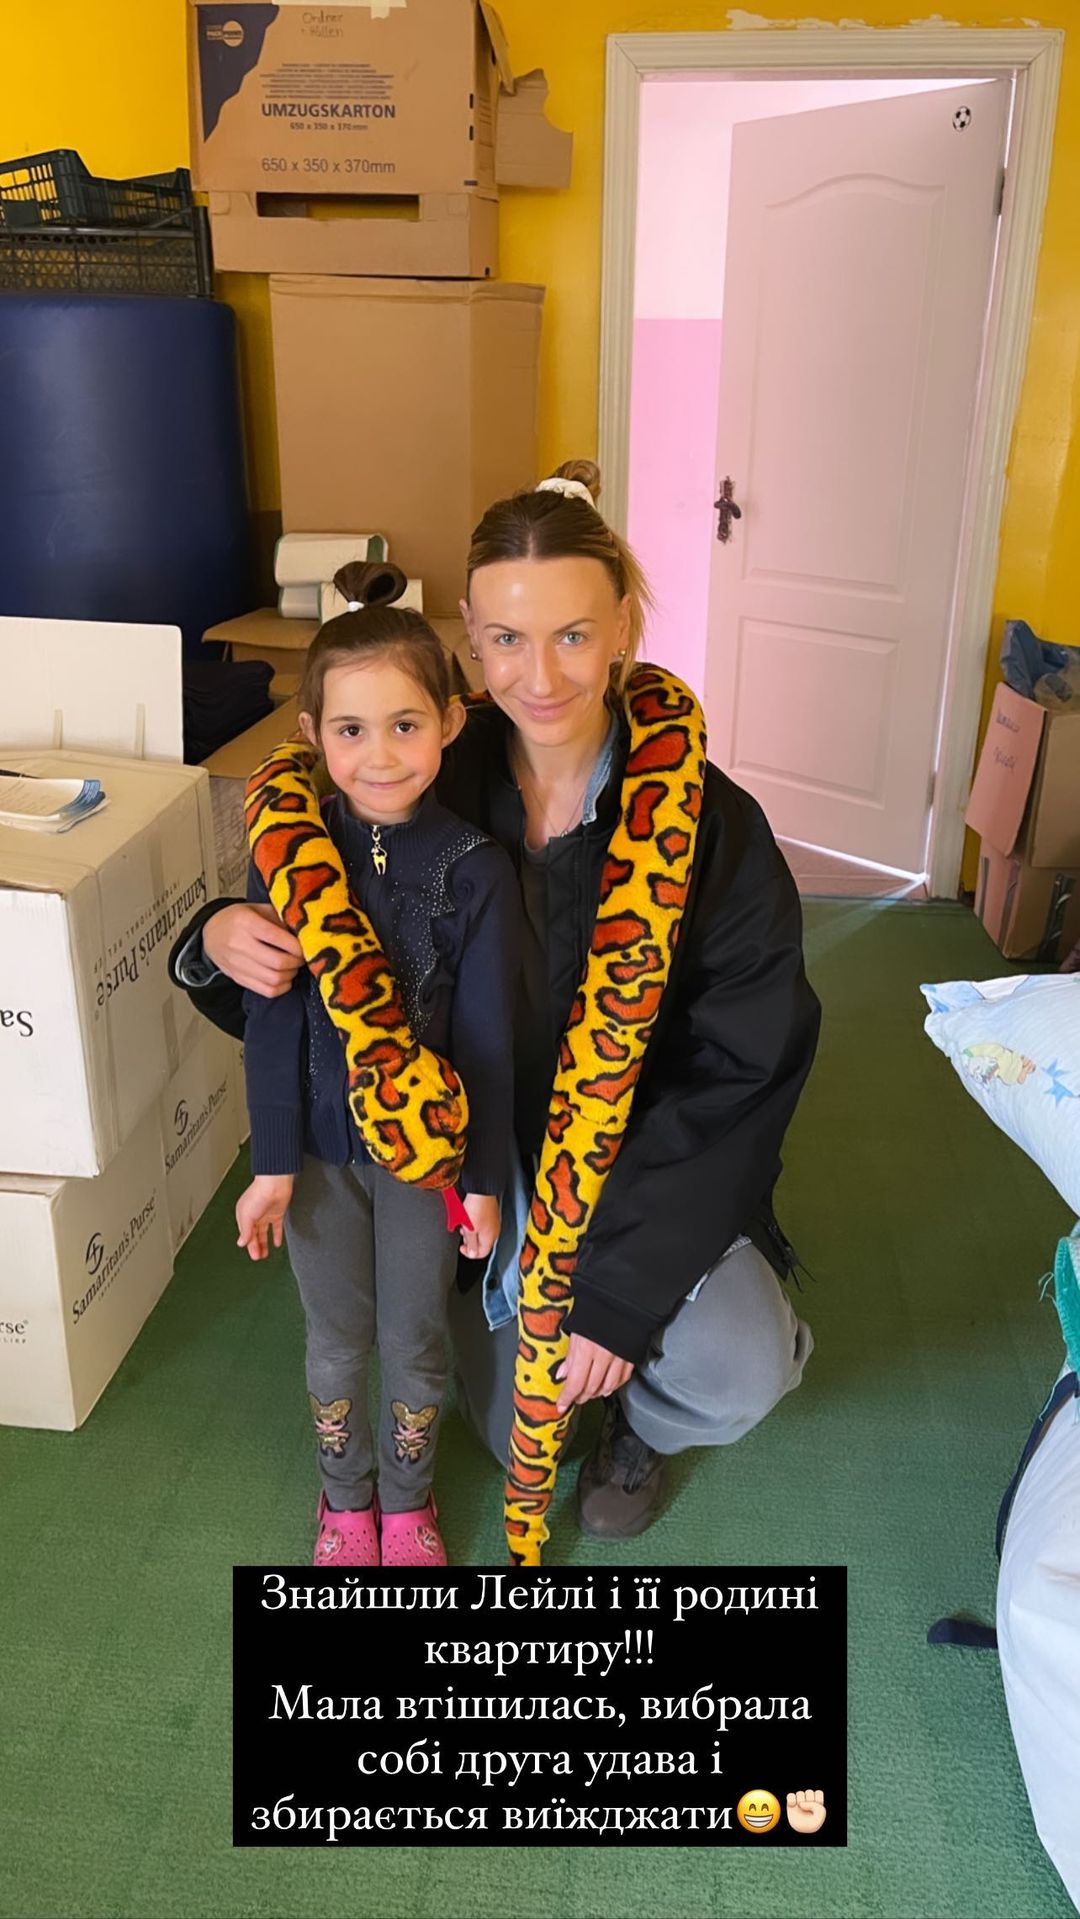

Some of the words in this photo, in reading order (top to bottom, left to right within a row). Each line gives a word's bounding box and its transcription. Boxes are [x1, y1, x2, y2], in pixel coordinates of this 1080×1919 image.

[262, 103, 396, 118] UMZUGSKARTON
[262, 158, 287, 172] 650
[291, 162, 299, 171] x
[303, 158, 328, 173] 350
[332, 162, 341, 172] x
[344, 159, 396, 173] 370mm
[138, 869, 207, 967] Samaritan's
[96, 945, 140, 1007] Purse
[72, 1231, 131, 1325] Samaritan's
[128, 1197, 155, 1239] Purse
